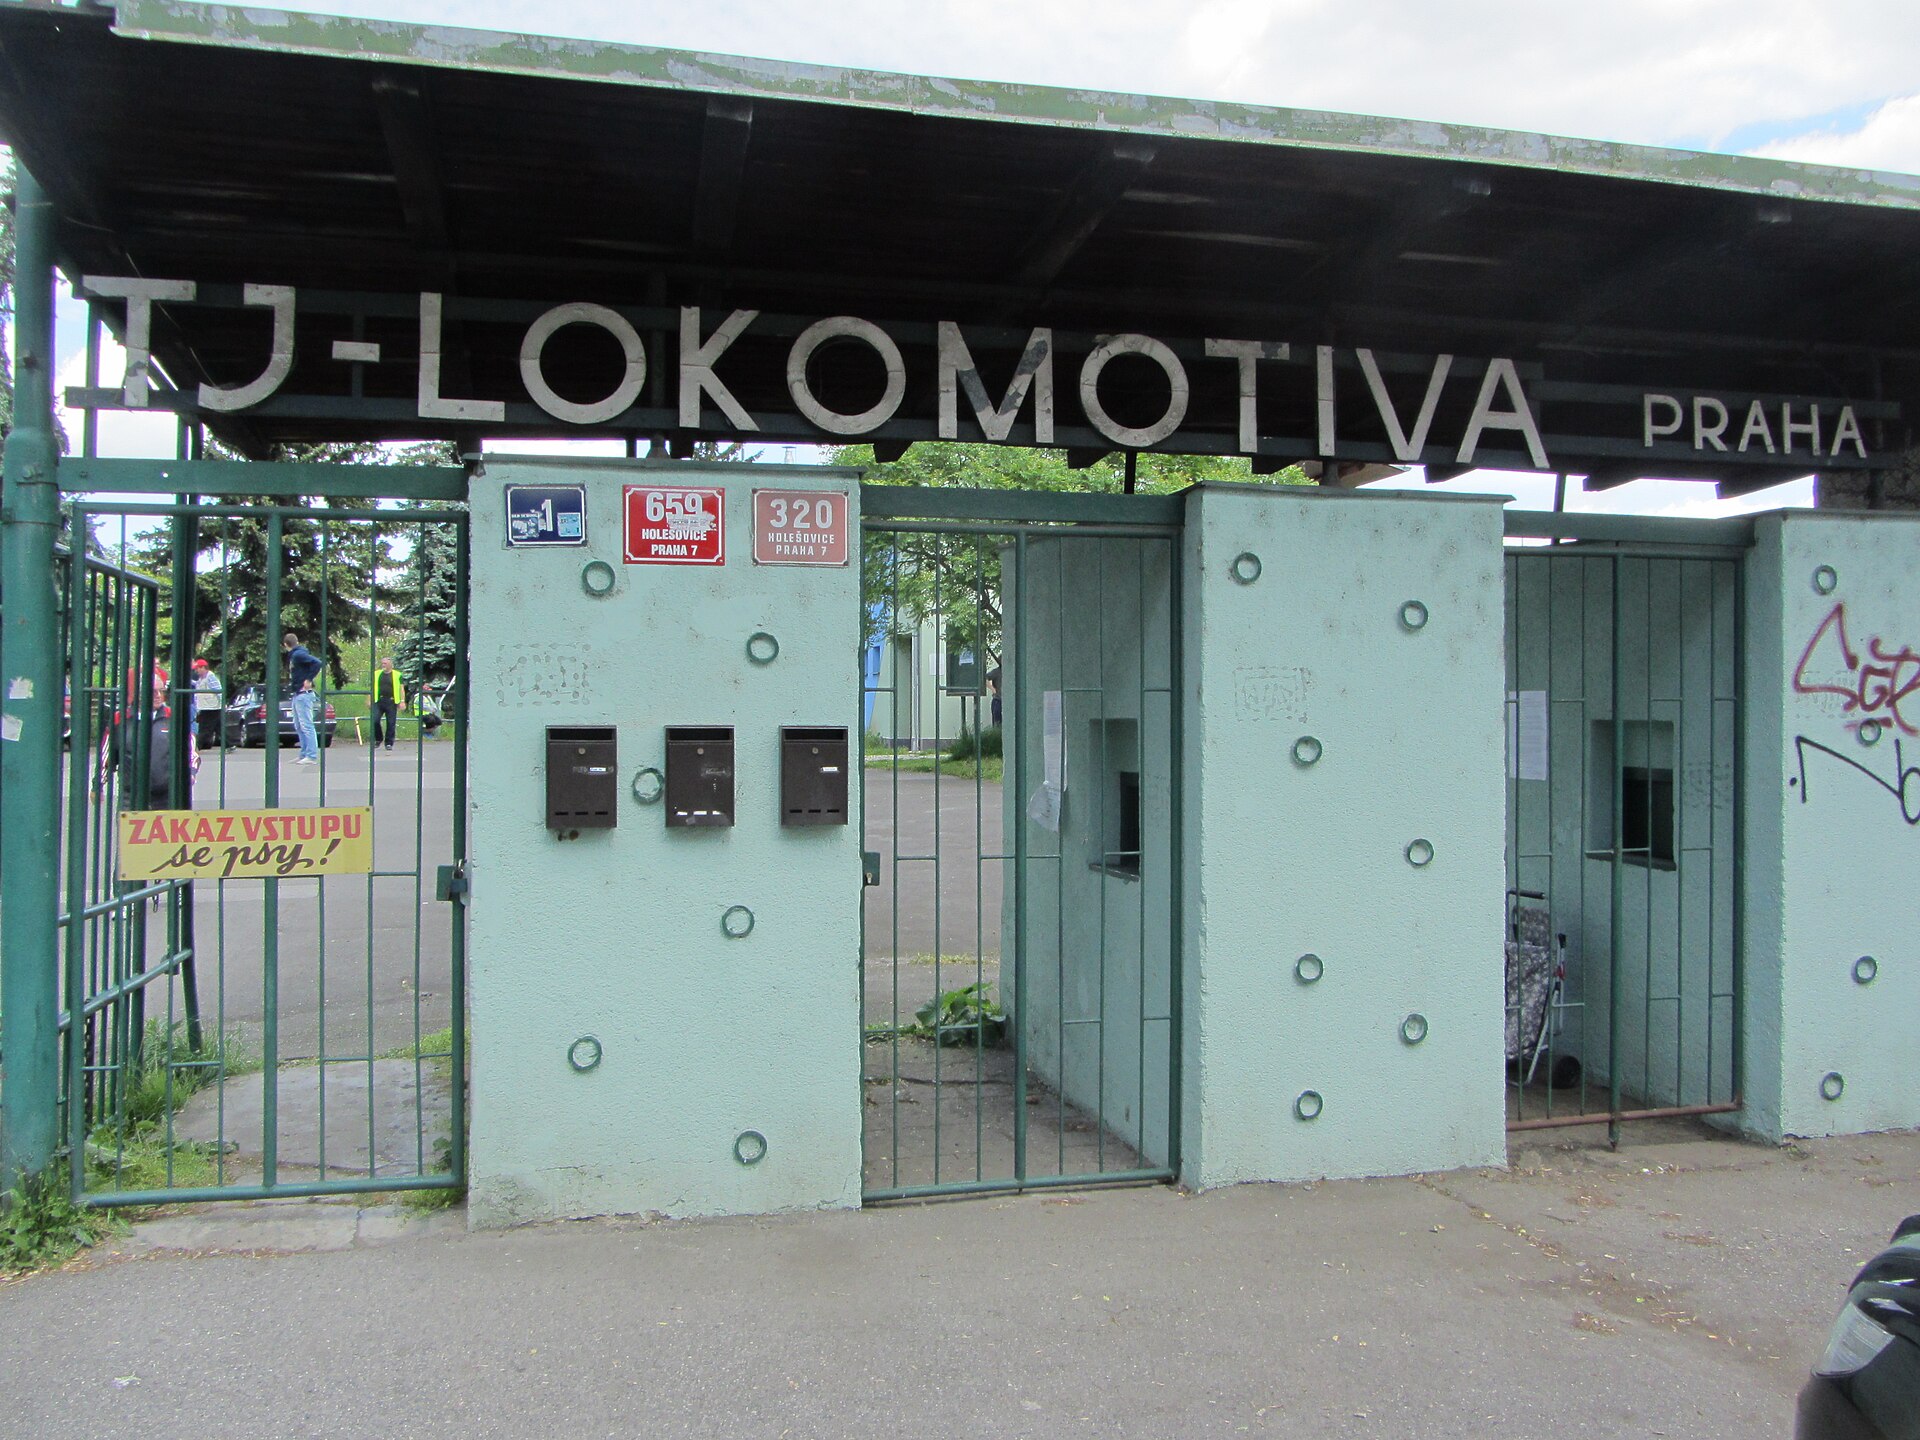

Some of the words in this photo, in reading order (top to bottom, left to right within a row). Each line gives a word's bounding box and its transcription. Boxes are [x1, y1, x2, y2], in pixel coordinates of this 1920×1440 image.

[1643, 393, 1867, 459] PRAHA
[541, 499, 553, 532] 1
[645, 491, 704, 523] 659
[769, 498, 833, 529] 320
[651, 544, 688, 556] PRAHA
[690, 544, 698, 556] 7
[768, 530, 835, 544] HOLEŠOVICE
[775, 544, 815, 556] PRAHA
[821, 546, 828, 556] 7
[128, 815, 236, 844] ZÁKAZ
[241, 814, 361, 842] VSTUPU
[150, 843, 214, 873] se
